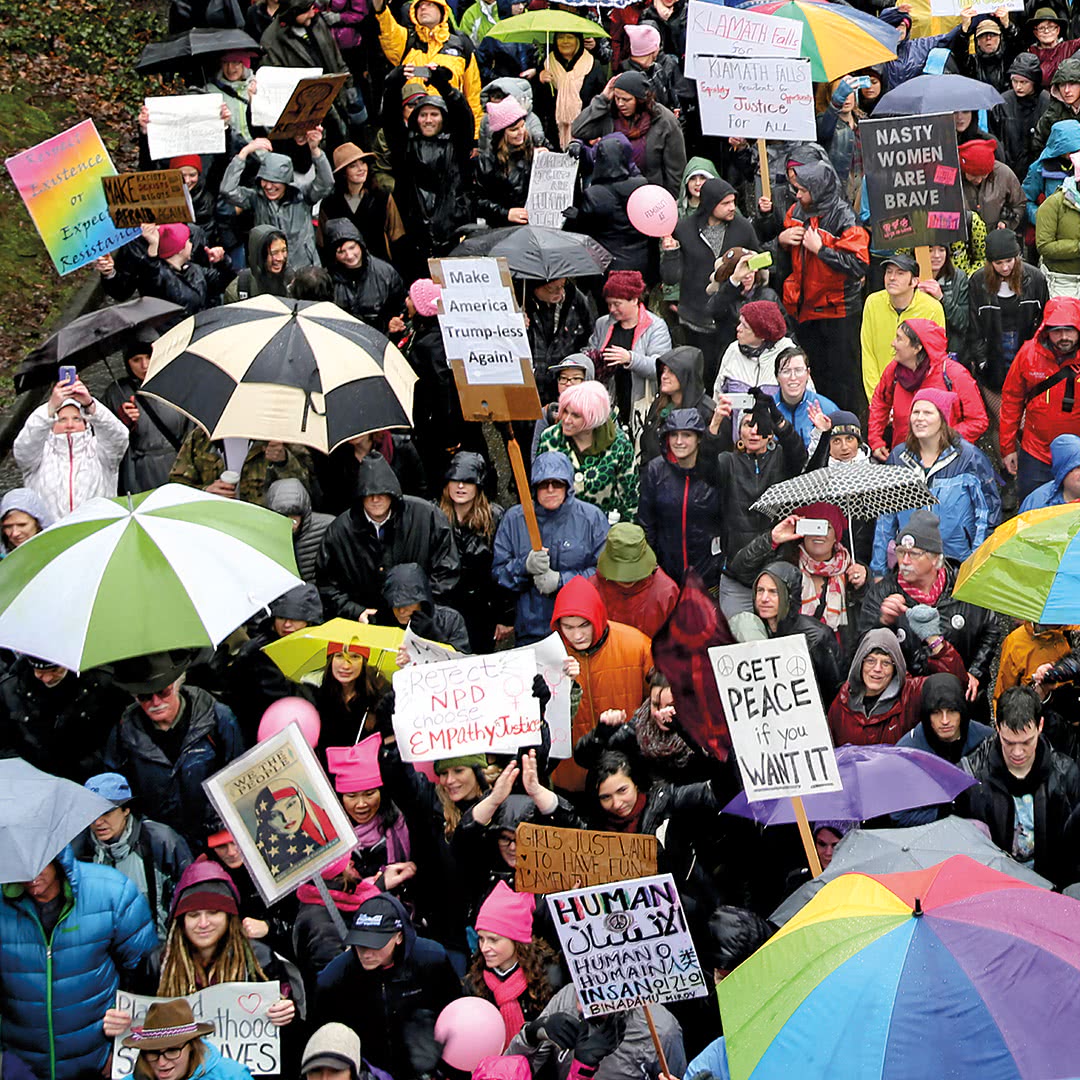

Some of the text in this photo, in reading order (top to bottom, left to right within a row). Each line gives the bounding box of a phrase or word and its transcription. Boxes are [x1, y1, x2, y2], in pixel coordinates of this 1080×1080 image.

[693, 9, 799, 47] KLAMATH Falls
[708, 59, 806, 82] KLAMATH FALLS
[734, 96, 788, 114] Justice
[728, 114, 792, 132] For ALL
[876, 124, 934, 146] NASTY
[24, 132, 82, 165] Respect
[878, 146, 942, 168] WOMEN
[30, 153, 104, 197] Existence
[136, 173, 166, 181] RACISTS
[894, 170, 926, 188] ARE
[103, 176, 138, 204] MAKE
[139, 182, 169, 192] SEXISTS
[141, 192, 170, 200] BIGOTS
[70, 192, 84, 206] or
[644, 200, 668, 219] FEMINIST
[884, 189, 939, 210] BRAVE
[116, 208, 156, 223] AFRAID
[450, 270, 490, 284] Make
[450, 299, 508, 312] America
[446, 324, 524, 340] Trump-less
[468, 351, 514, 366] Again!
[736, 656, 781, 682] GET
[431, 685, 485, 712] NPD
[728, 679, 812, 722] PEACE
[413, 706, 481, 729] choose
[756, 722, 808, 749] if you
[233, 750, 285, 789] WE THE
[238, 759, 288, 796] PEOPLE
[740, 746, 829, 786] WANT IT
[518, 826, 654, 862] GIRLS JUST WANT
[533, 851, 642, 877] TO HAVE FUN
[554, 882, 676, 924] HUMAN
[580, 960, 668, 988] HUMAIN
[580, 978, 654, 1005] INSAN
[590, 993, 660, 1015] BINADAMU
